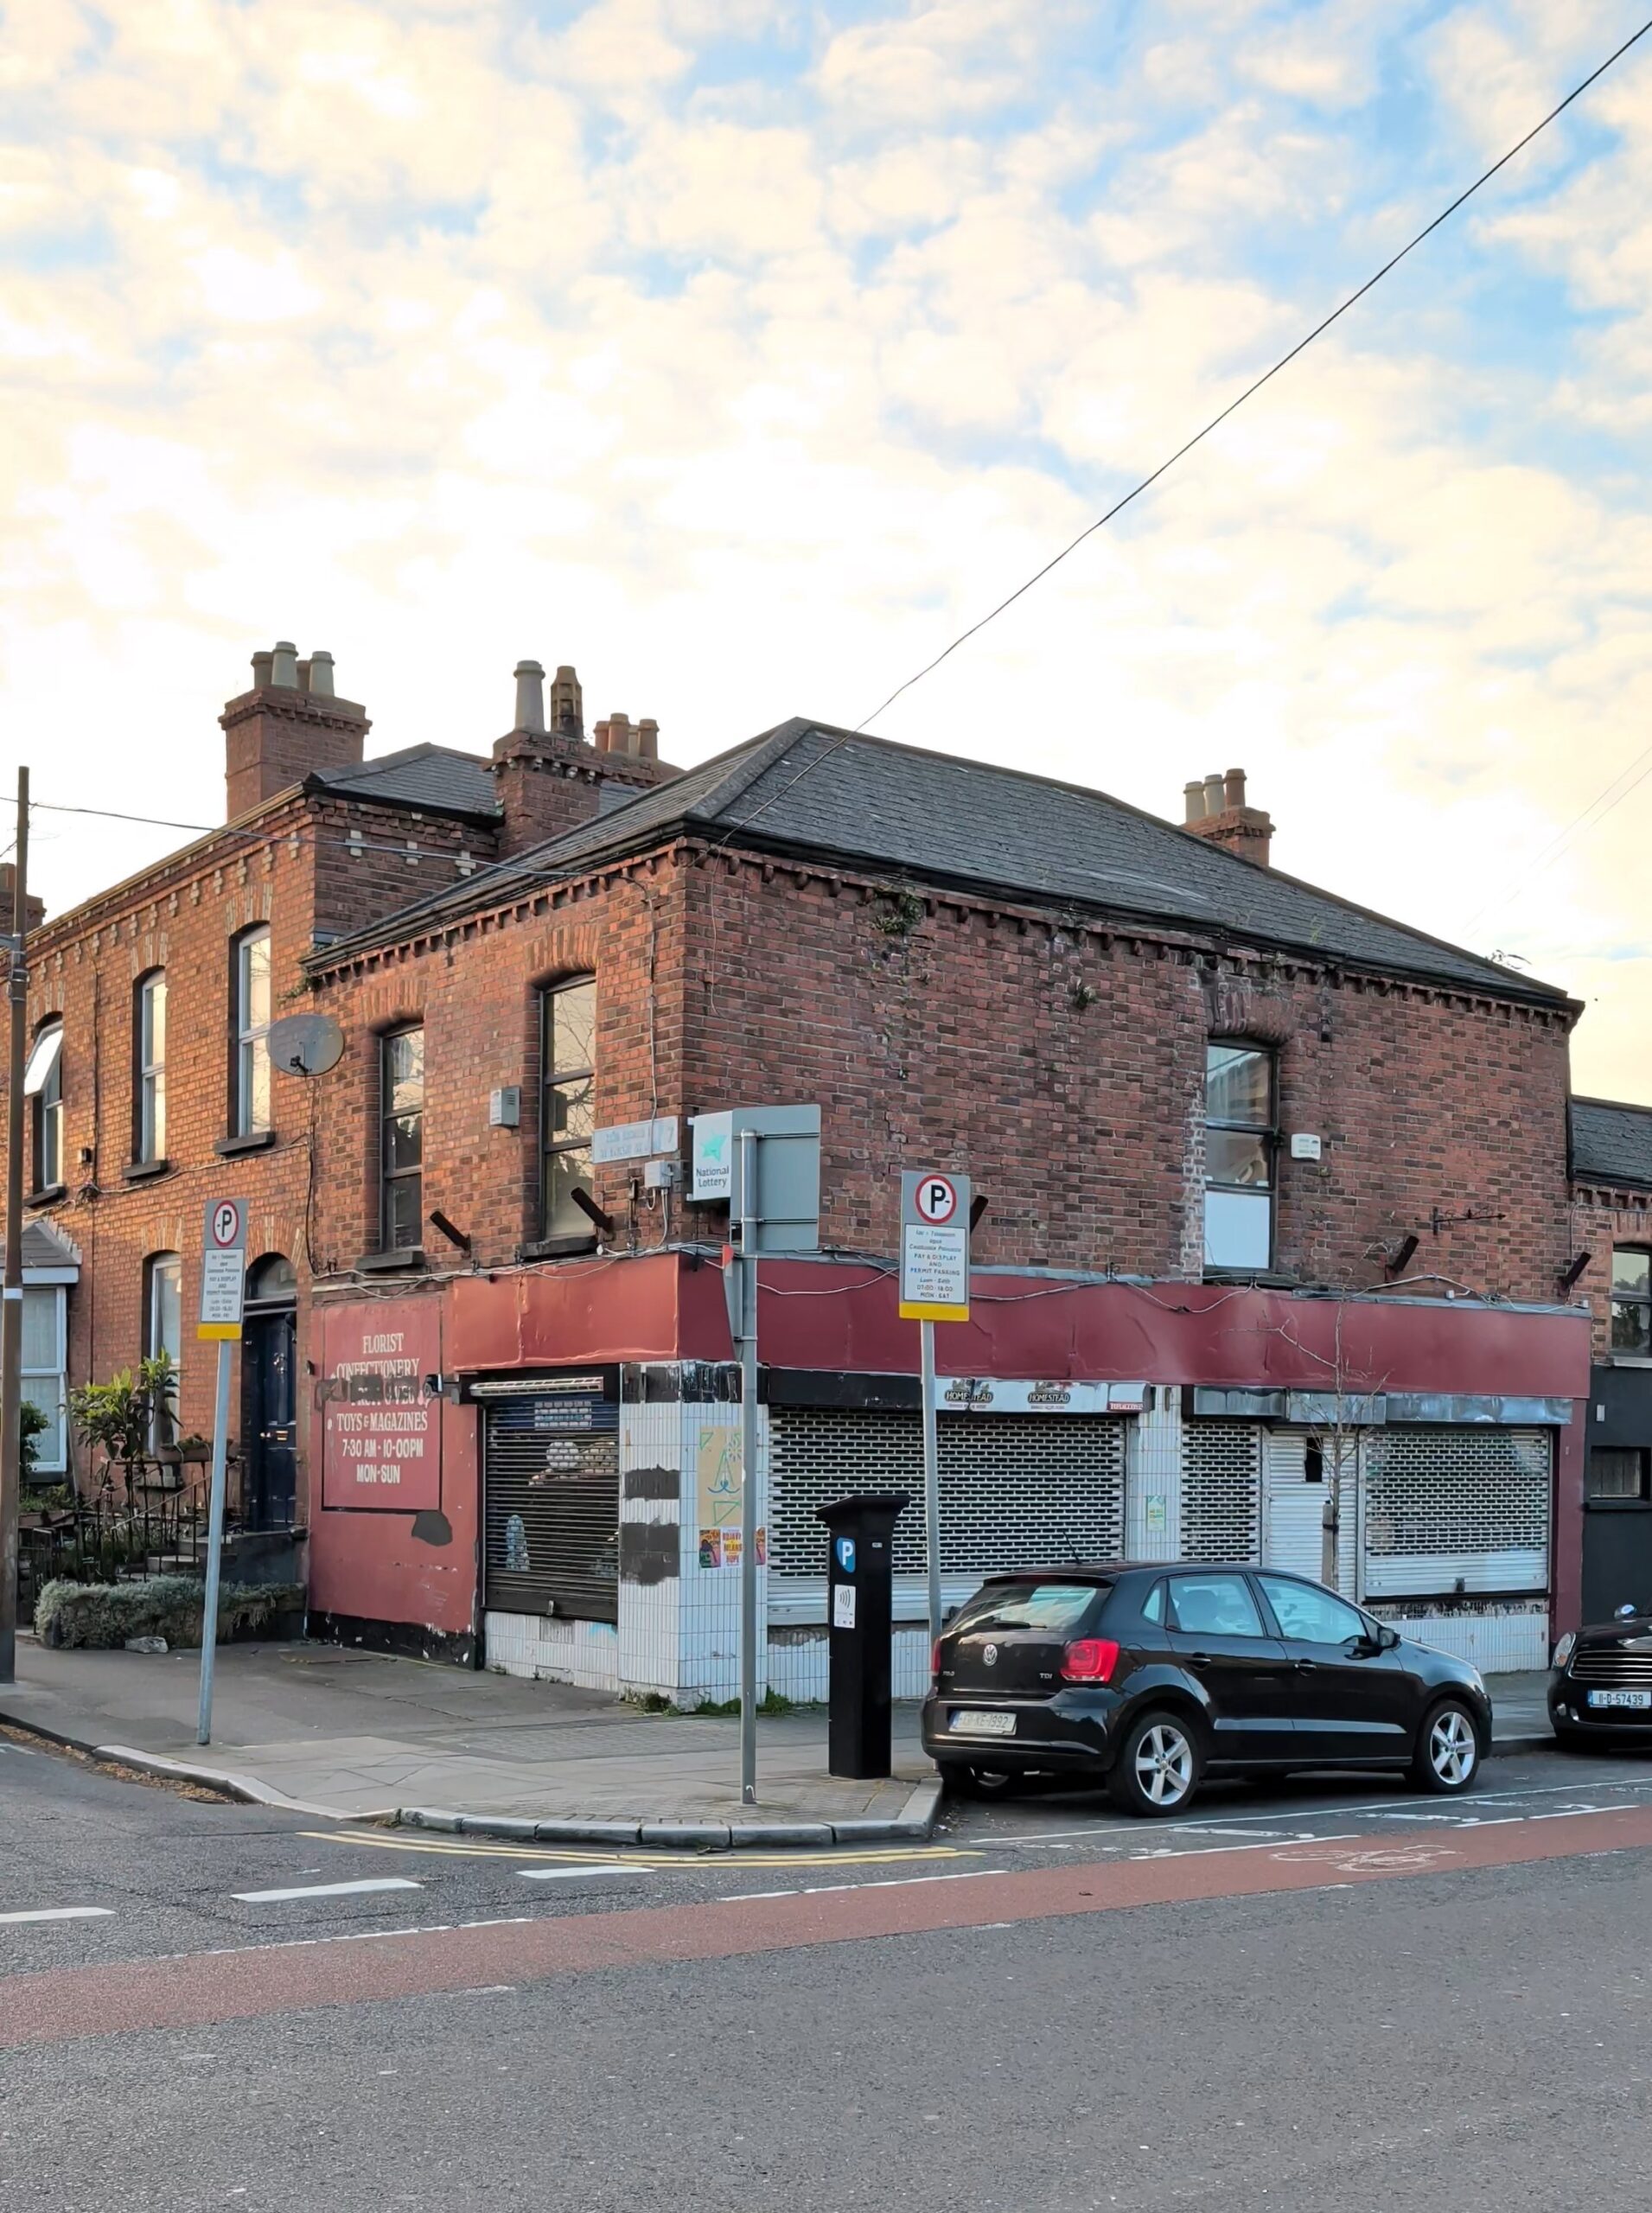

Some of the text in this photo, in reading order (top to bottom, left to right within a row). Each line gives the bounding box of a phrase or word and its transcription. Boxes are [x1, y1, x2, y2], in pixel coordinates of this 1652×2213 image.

[696, 1165, 730, 1177] National
[698, 1177, 727, 1188] Lottery
[930, 1184, 947, 1214] P
[221, 1209, 233, 1238] P
[362, 1333, 405, 1354] FLORIST
[947, 1391, 1069, 1402] HOMETEAD HOMESTEAD
[336, 1413, 363, 1432] TOYS
[369, 1411, 428, 1432] MAGAZINES
[842, 1541, 854, 1566] P
